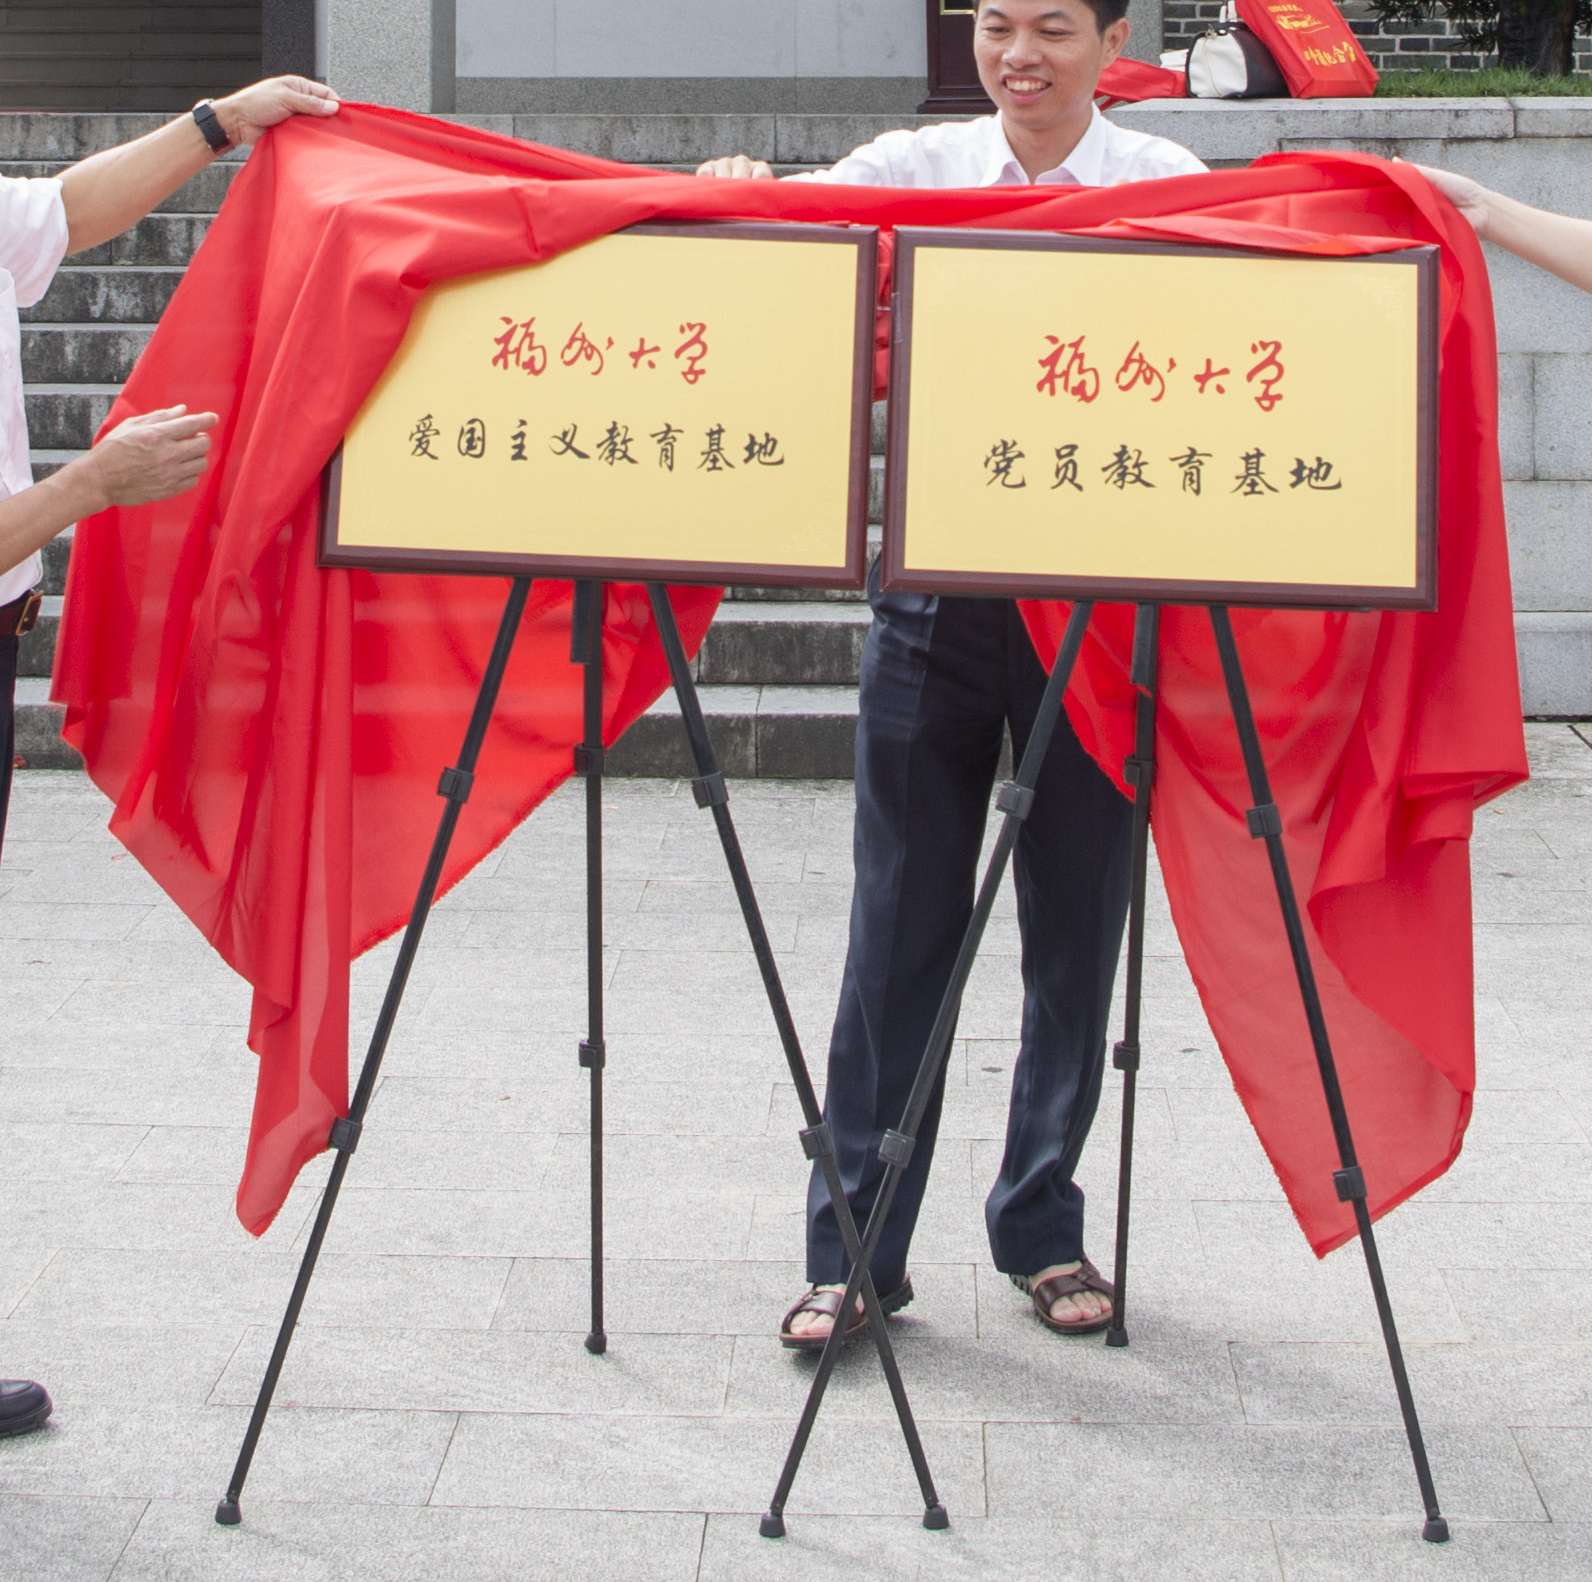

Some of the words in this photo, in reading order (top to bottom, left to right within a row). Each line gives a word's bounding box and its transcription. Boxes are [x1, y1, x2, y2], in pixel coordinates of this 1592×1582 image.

[491, 316, 709, 385] 福州大学
[1035, 334, 1285, 412] 福州大学
[408, 414, 786, 472] 爱国主义教育基地
[983, 438, 1342, 496] 党员教育基地
